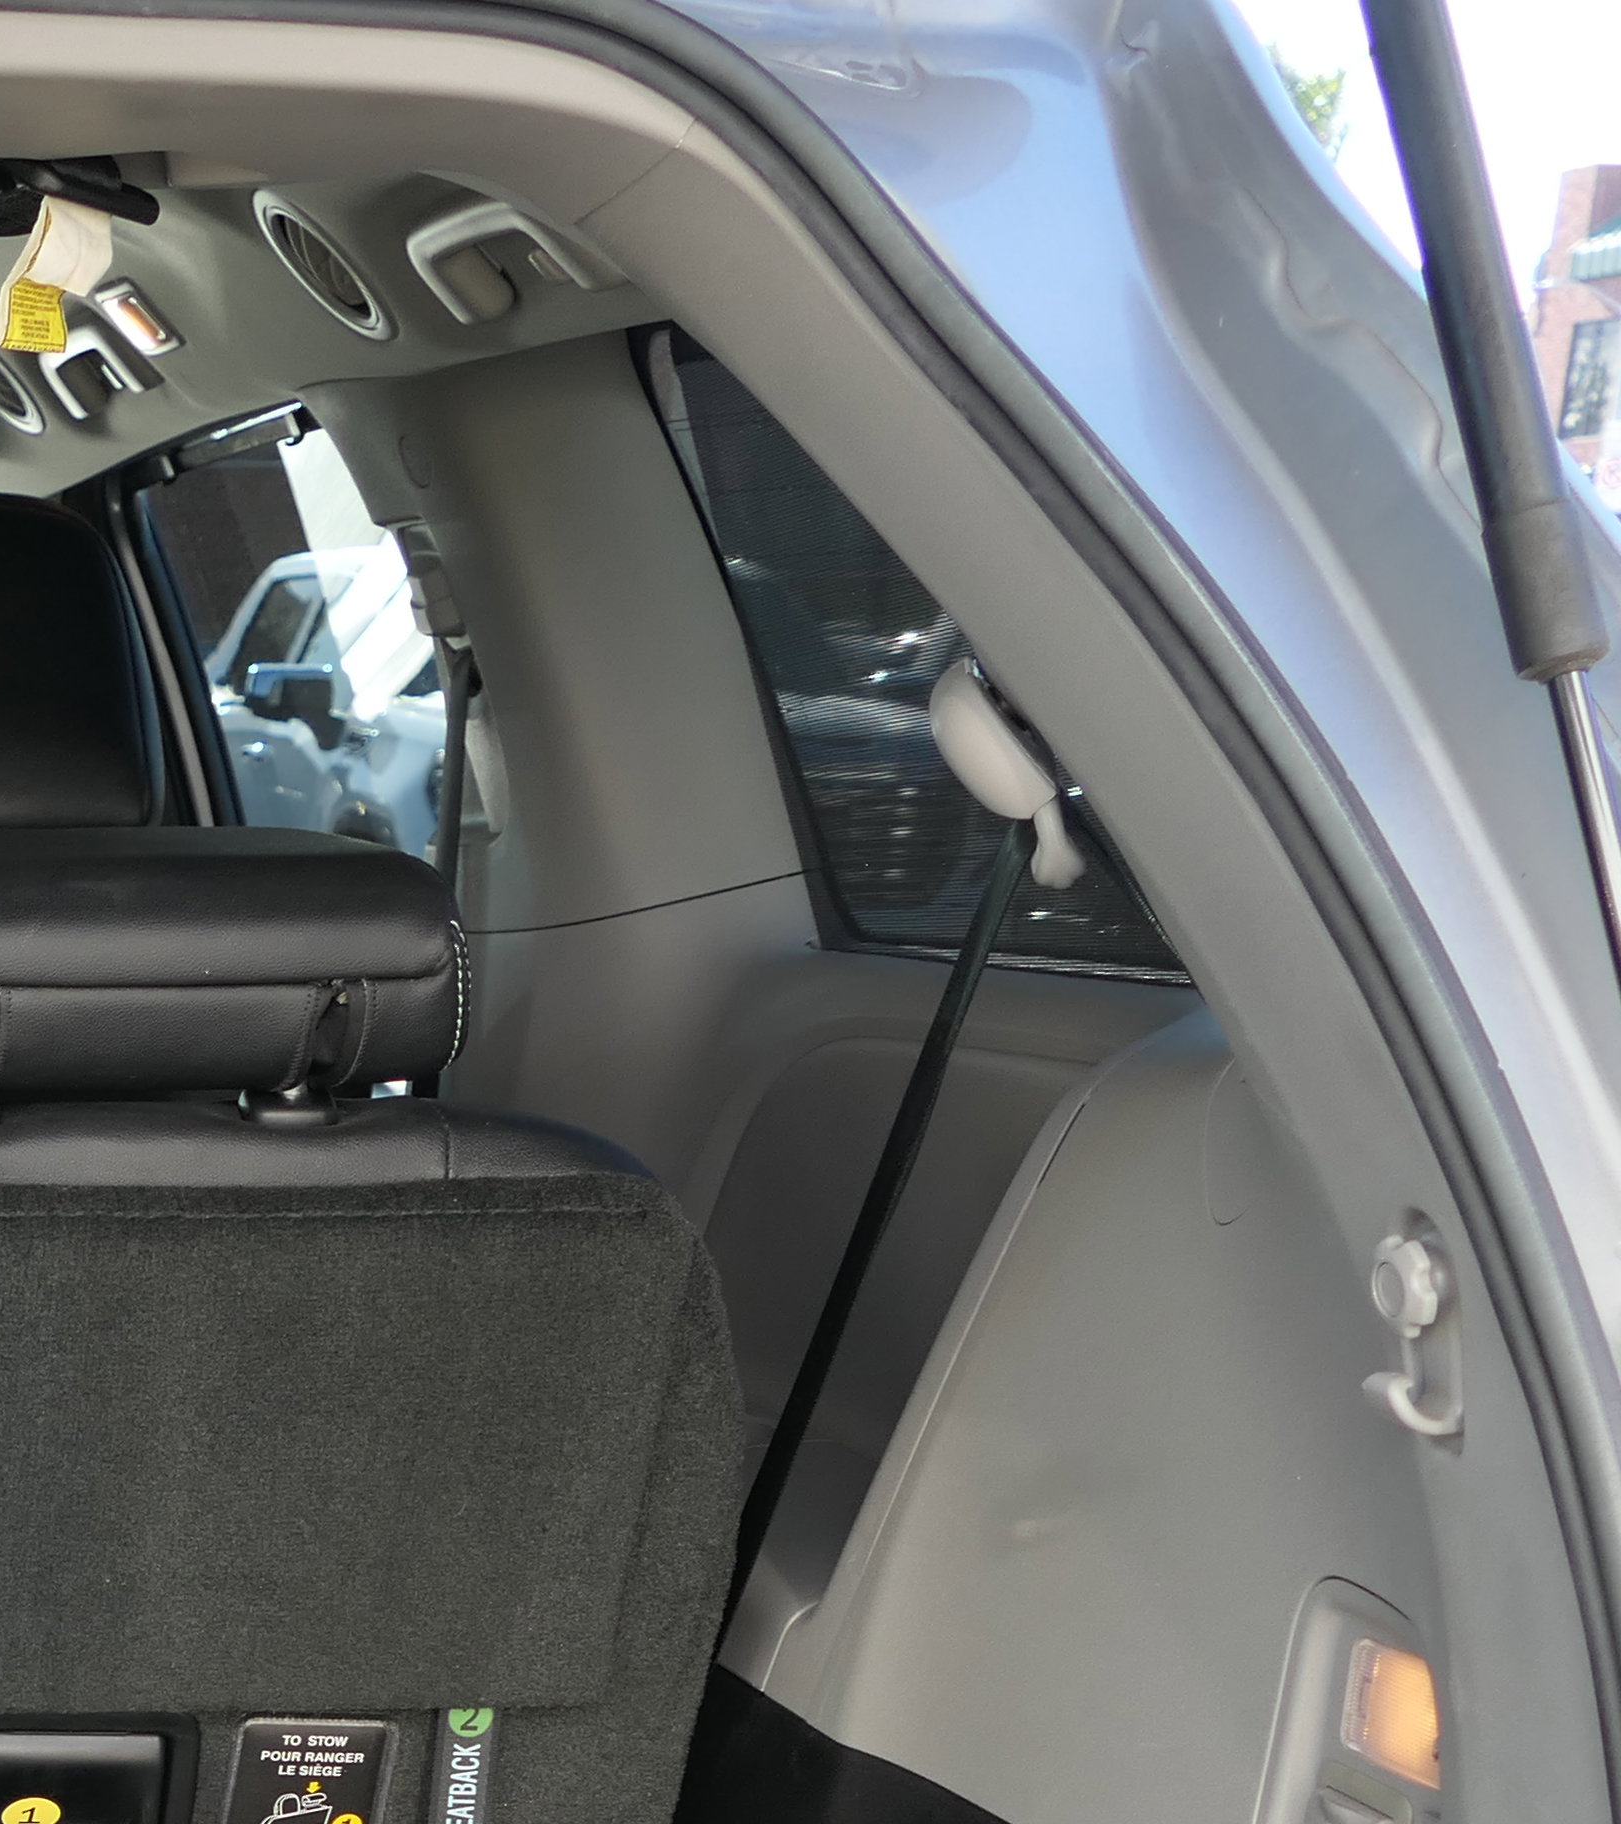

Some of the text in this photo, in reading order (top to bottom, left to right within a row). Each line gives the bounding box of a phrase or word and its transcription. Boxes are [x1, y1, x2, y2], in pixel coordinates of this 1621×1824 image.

[459, 1708, 479, 1731] 2
[282, 1735, 349, 1747] TO STOW
[260, 1751, 365, 1763] POUR RANGER
[278, 1765, 296, 1776] LE
[18, 1807, 41, 1824] 1
